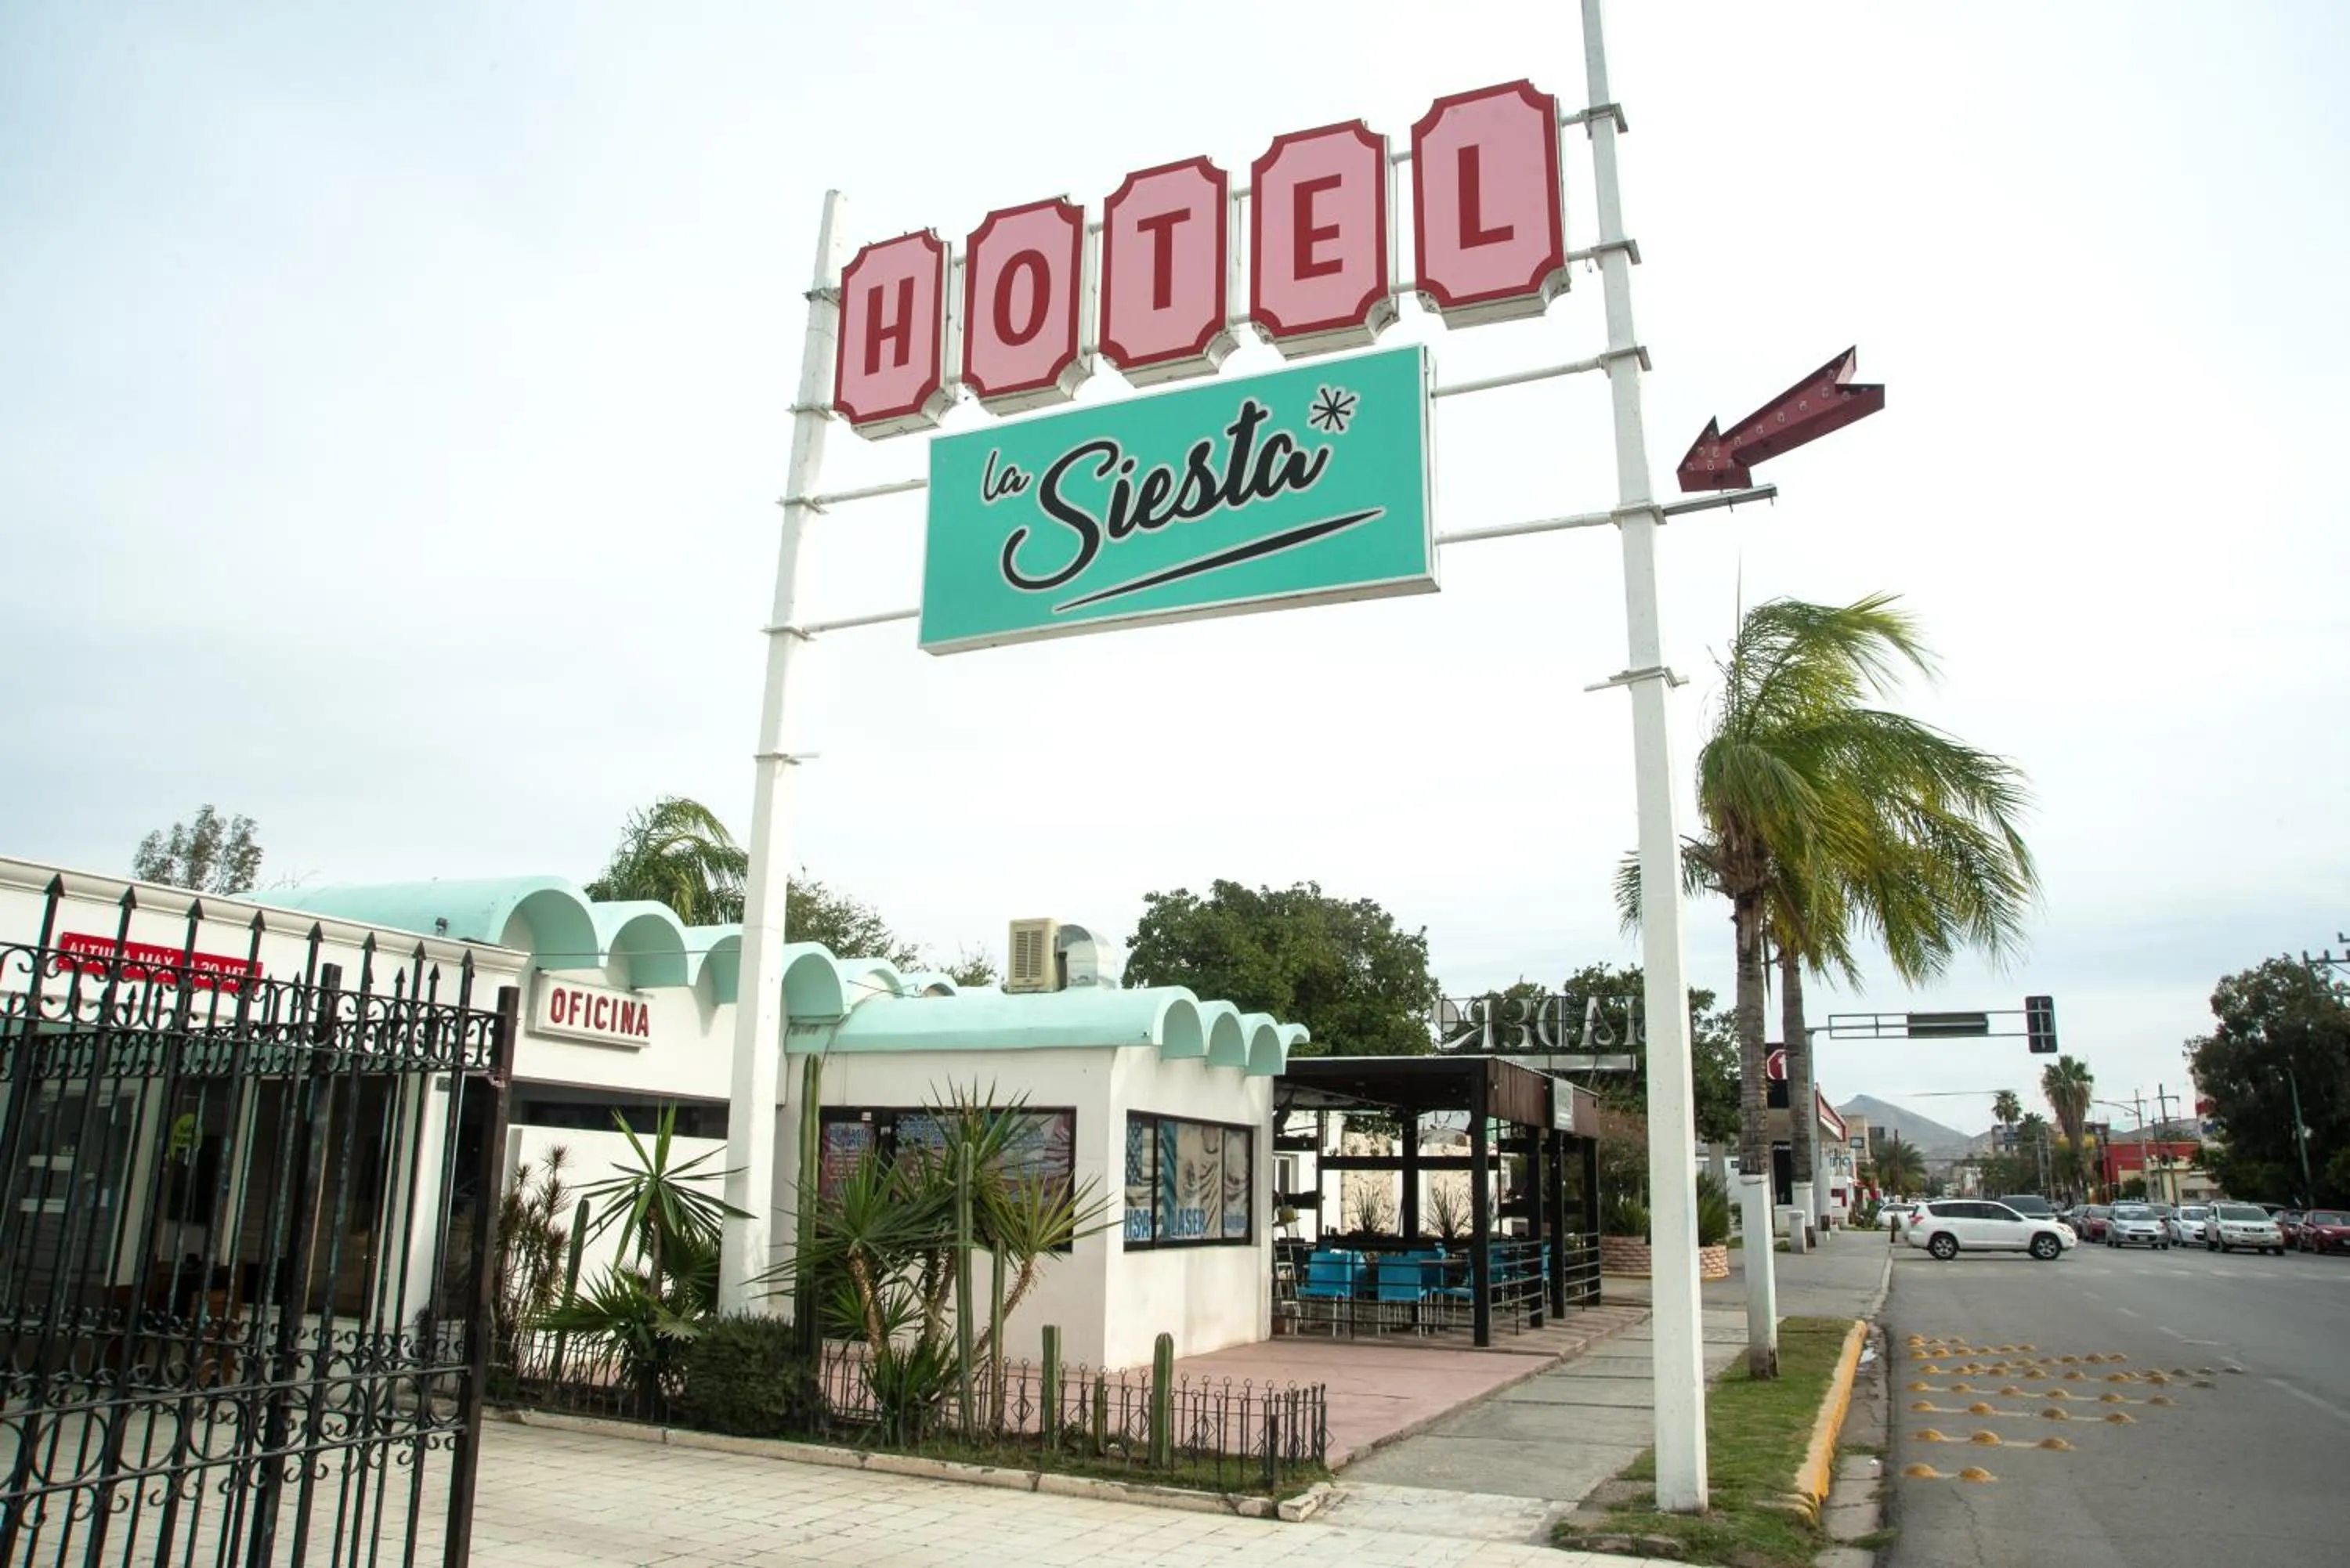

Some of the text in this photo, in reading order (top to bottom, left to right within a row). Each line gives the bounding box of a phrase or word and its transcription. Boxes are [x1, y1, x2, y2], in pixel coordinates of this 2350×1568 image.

[863, 144, 1514, 377] HOTEL
[982, 399, 1330, 591] la Siesta
[550, 988, 649, 1038] OFICINA
